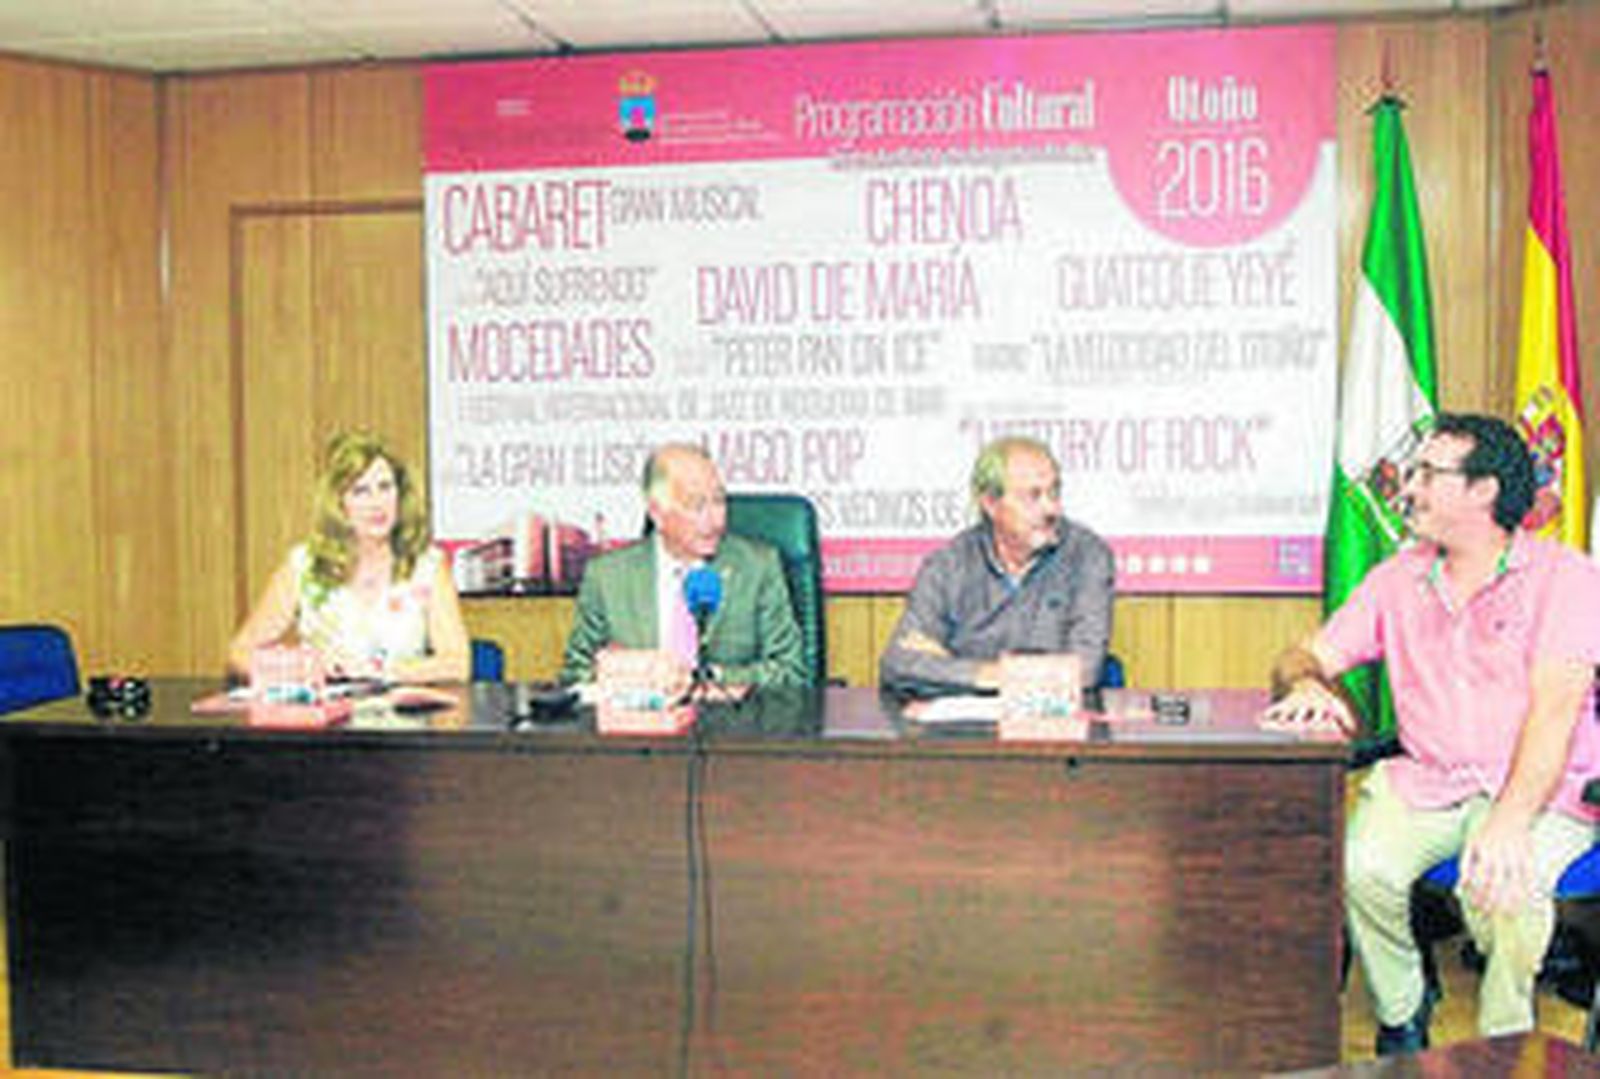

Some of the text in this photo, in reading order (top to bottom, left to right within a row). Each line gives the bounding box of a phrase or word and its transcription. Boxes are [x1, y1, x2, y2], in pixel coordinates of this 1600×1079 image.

[983, 79, 1096, 132] Cultural
[866, 175, 1023, 246] CHENOA
[1155, 137, 1270, 219] 2016
[443, 180, 611, 255] CABARET
[696, 246, 982, 326] DAVID DE MARÍA
[448, 319, 655, 383] MOCEDADES
[804, 428, 866, 482] POP
[1116, 417, 1160, 472] OF
[1166, 415, 1273, 471] ROCK"
